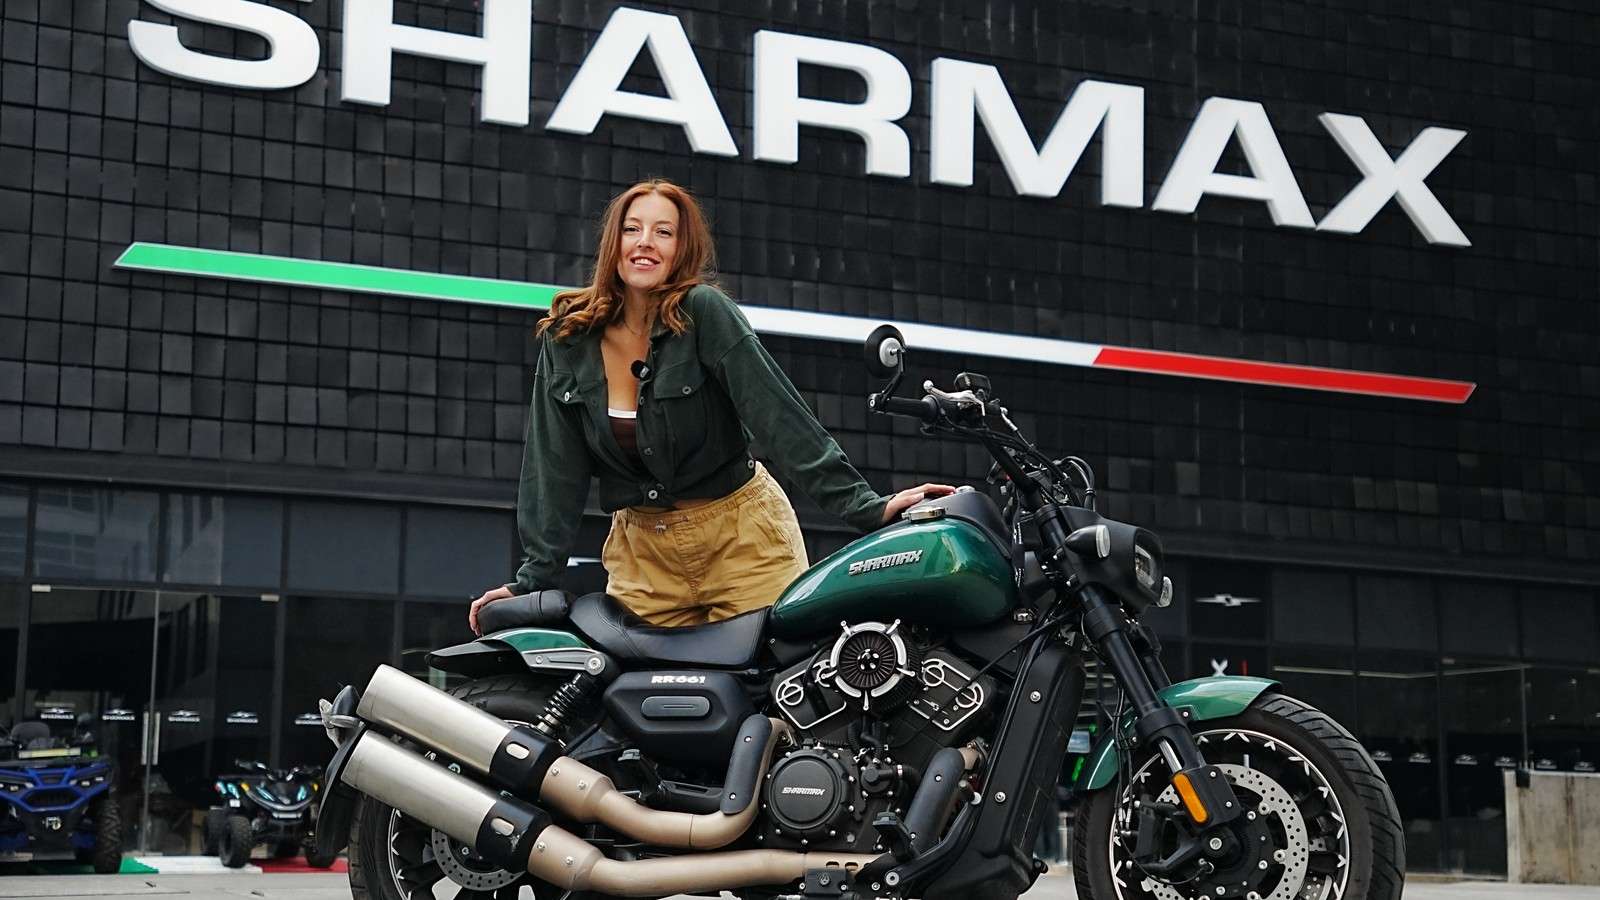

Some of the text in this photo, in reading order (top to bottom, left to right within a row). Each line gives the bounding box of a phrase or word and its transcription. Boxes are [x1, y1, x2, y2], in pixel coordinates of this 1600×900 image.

[127, 0, 1472, 247] SHARMAX
[848, 549, 923, 576] SHARMAX
[651, 675, 706, 684] RR661
